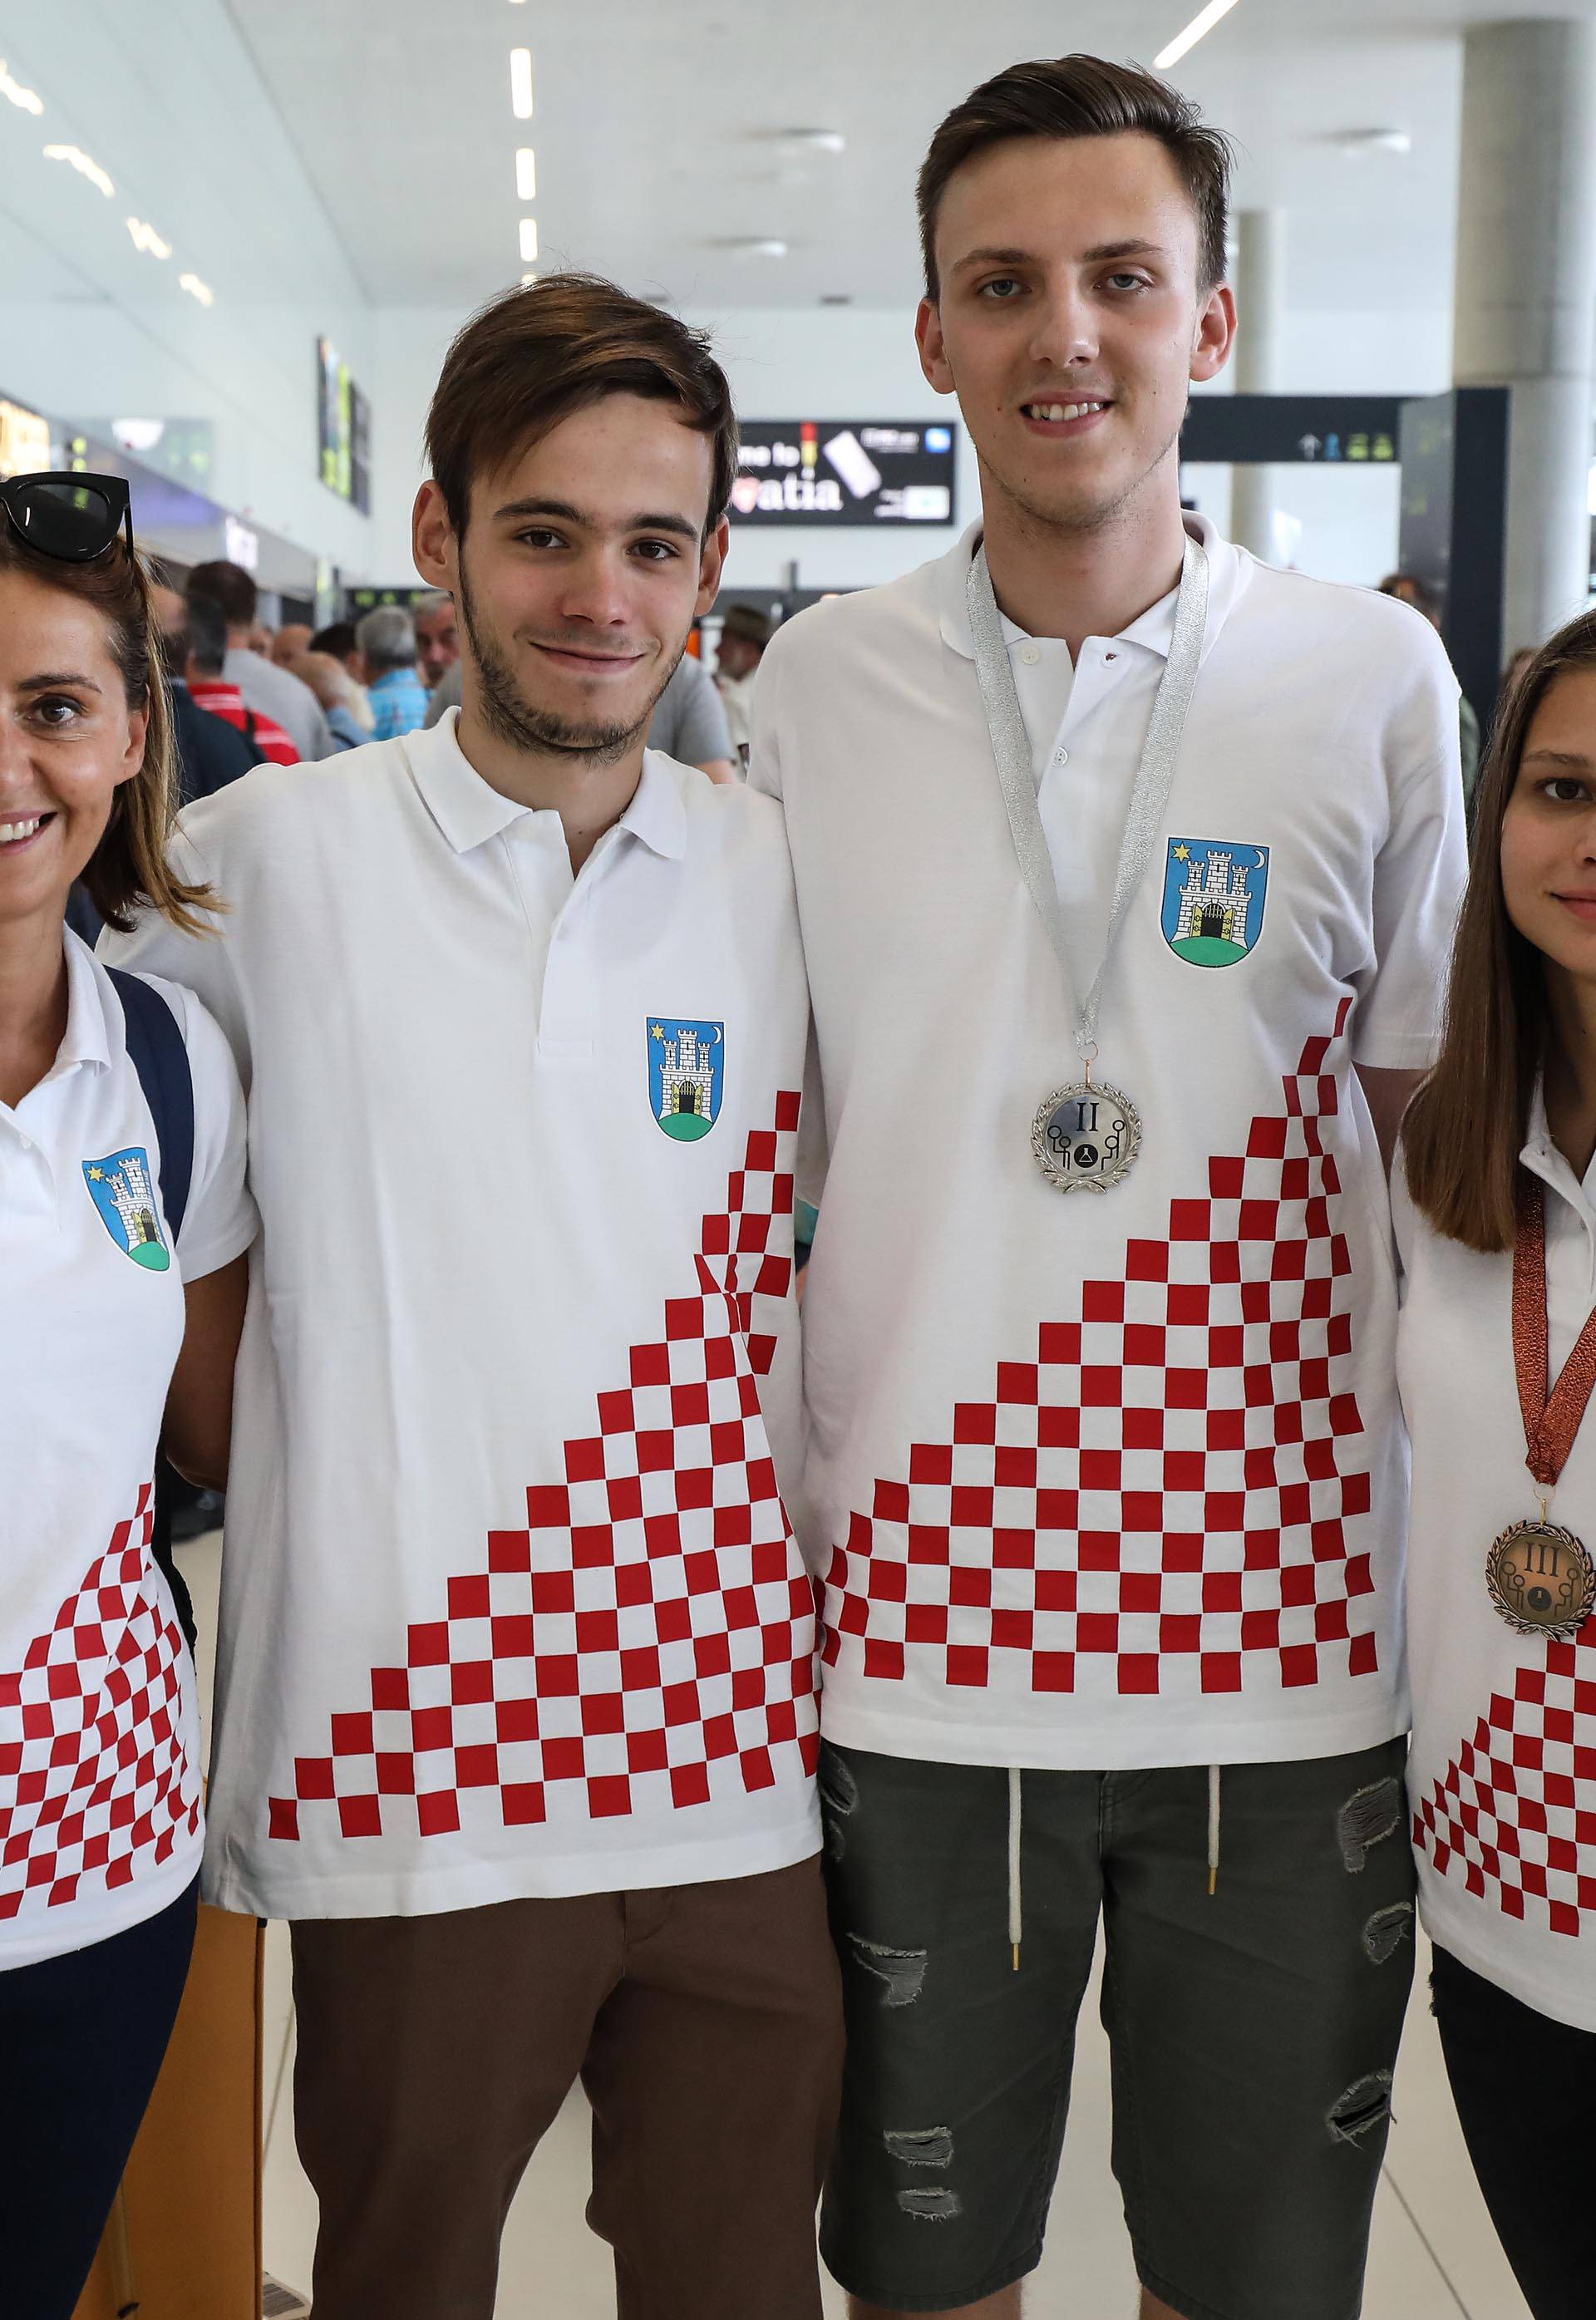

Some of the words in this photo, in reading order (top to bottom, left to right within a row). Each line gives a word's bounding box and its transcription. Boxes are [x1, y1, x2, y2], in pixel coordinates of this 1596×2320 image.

[772, 441, 800, 467] to
[1076, 1102, 1100, 1132] II
[1524, 1542, 1560, 1578] III
